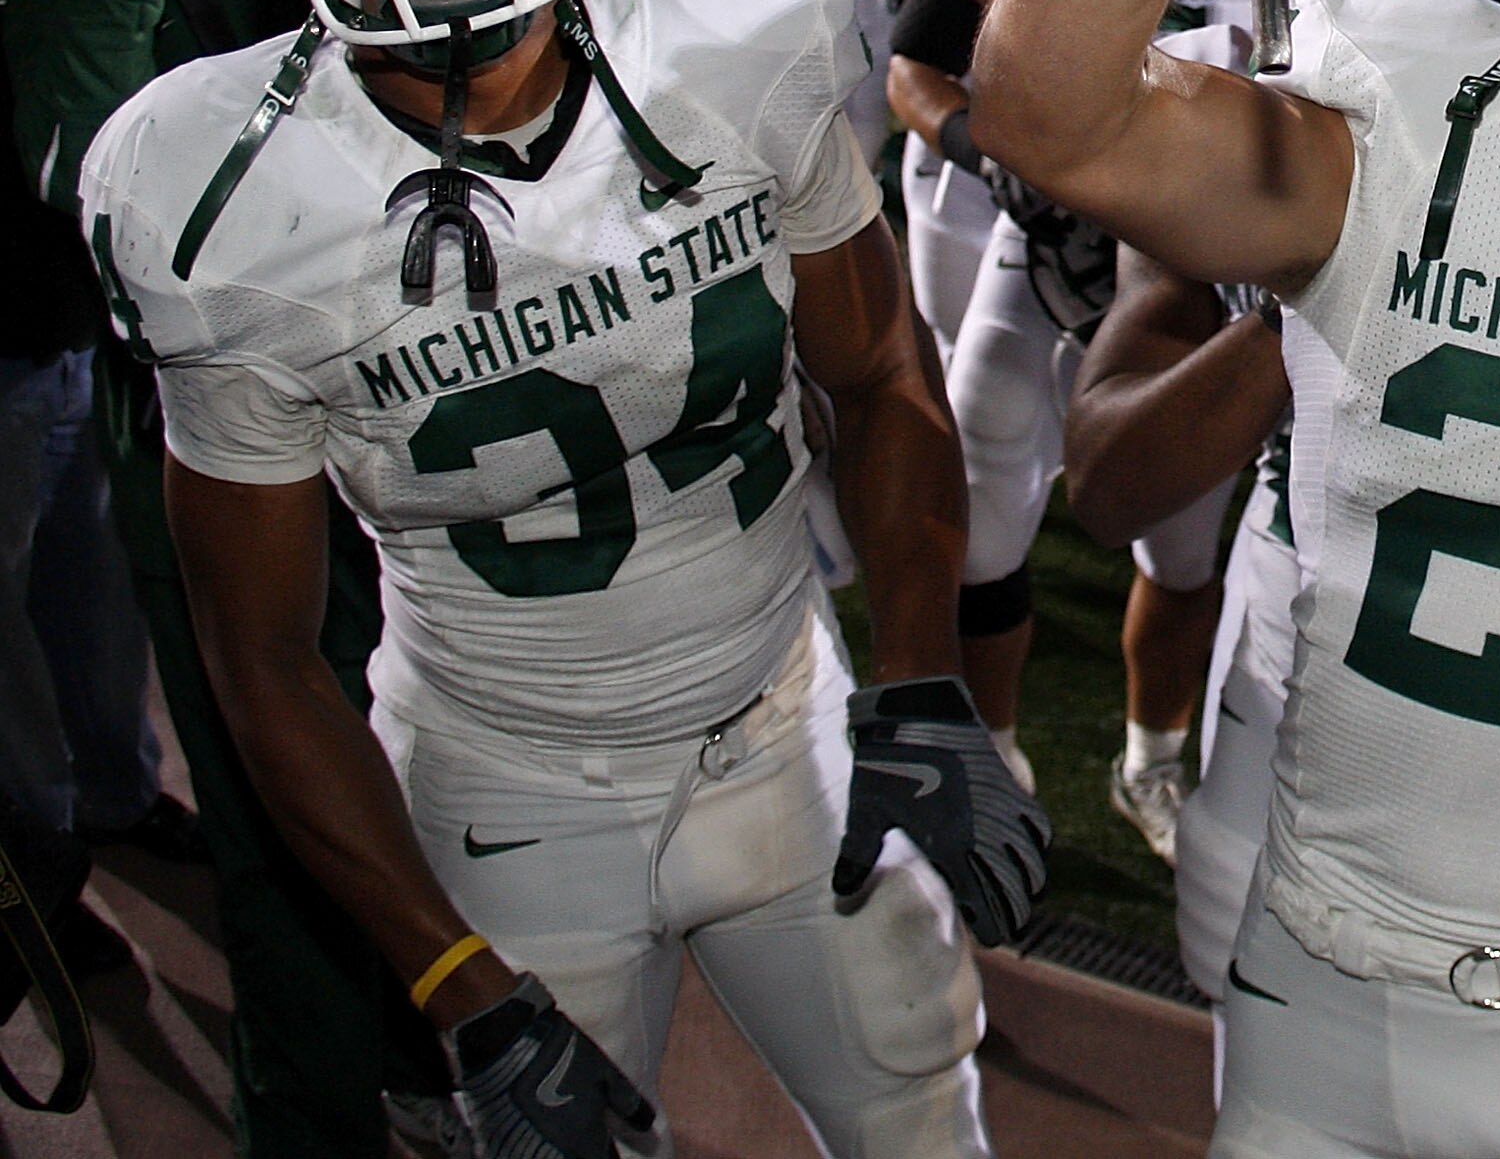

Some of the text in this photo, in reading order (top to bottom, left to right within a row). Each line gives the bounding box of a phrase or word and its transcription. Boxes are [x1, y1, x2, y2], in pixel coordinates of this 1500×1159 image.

[355, 190, 776, 409] MICHIGAN STATE
[407, 262, 794, 598] 34
